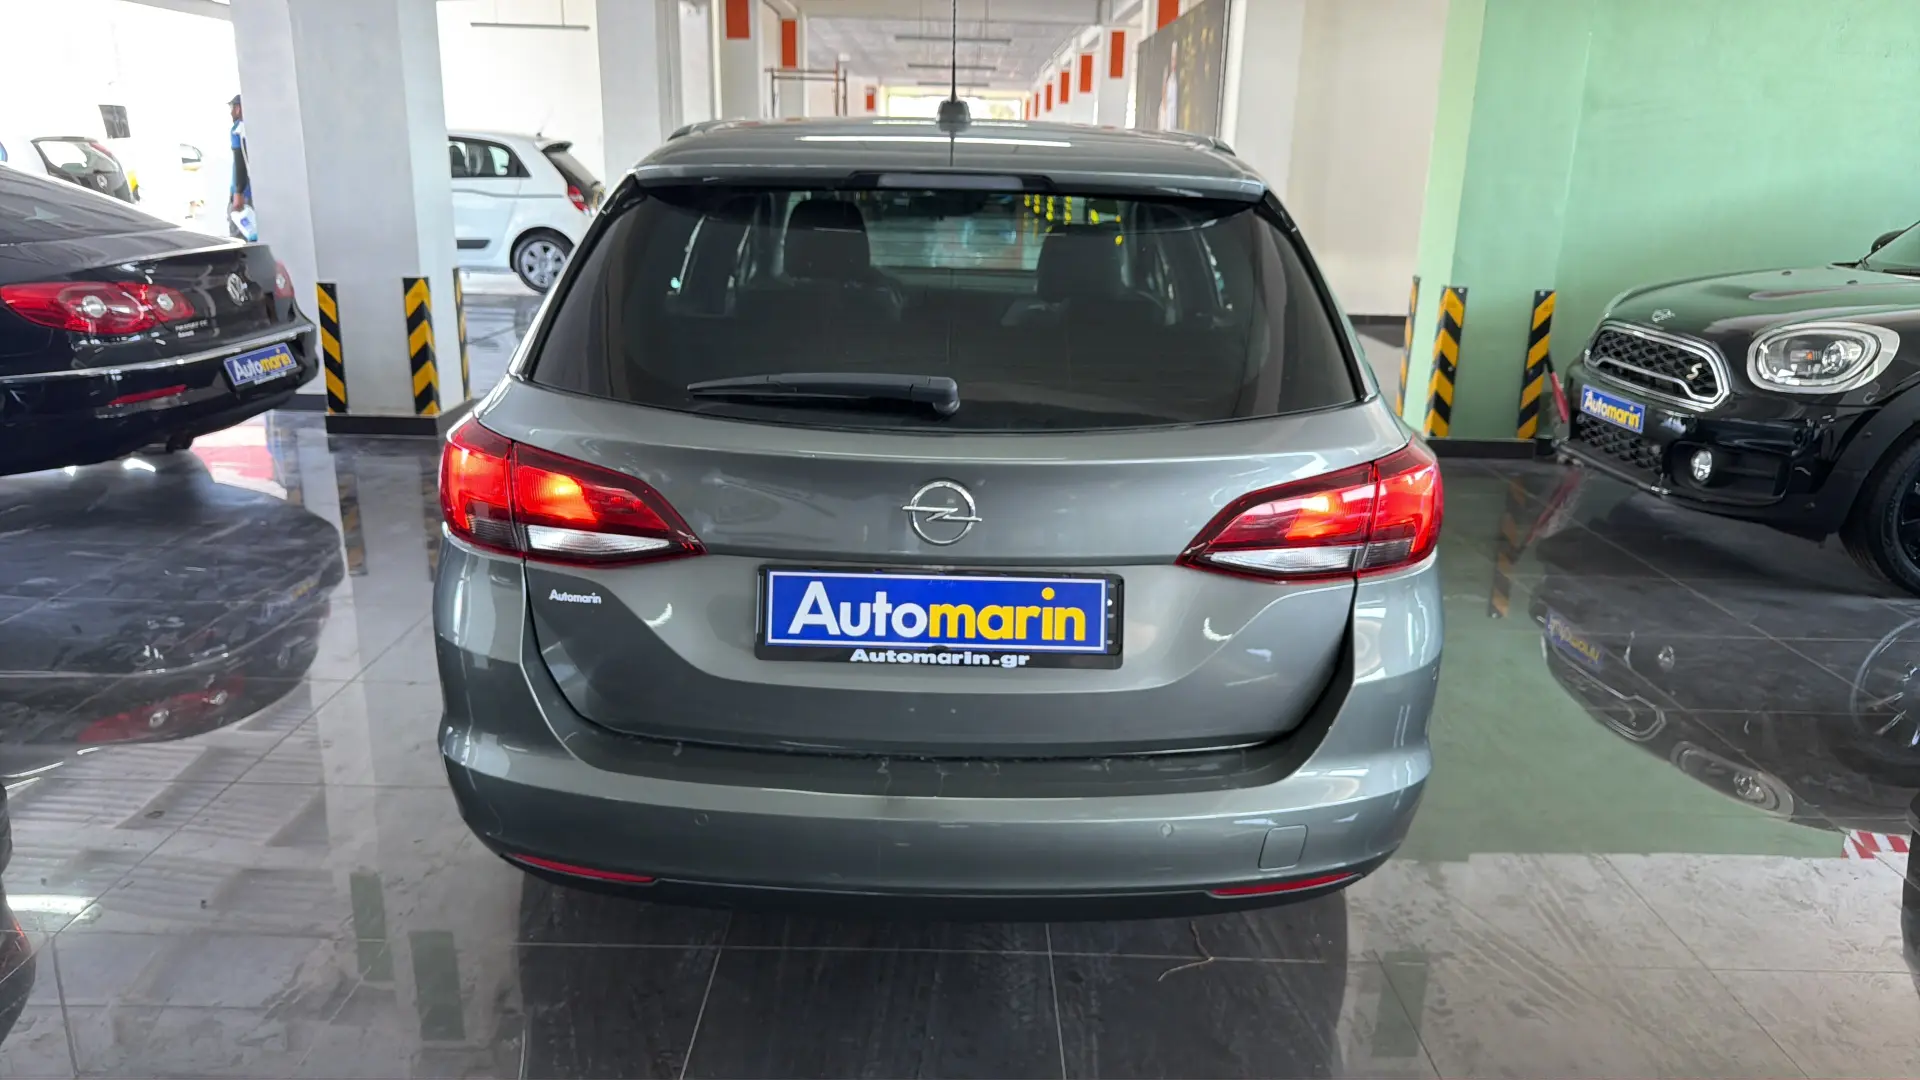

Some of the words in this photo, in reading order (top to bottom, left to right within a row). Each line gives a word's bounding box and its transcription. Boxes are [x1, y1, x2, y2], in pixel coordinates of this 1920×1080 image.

[1584, 391, 1640, 430] Automarin
[548, 588, 602, 604] Automarin
[787, 580, 1086, 641] Automarin
[850, 648, 1030, 668] Automarin.gr
